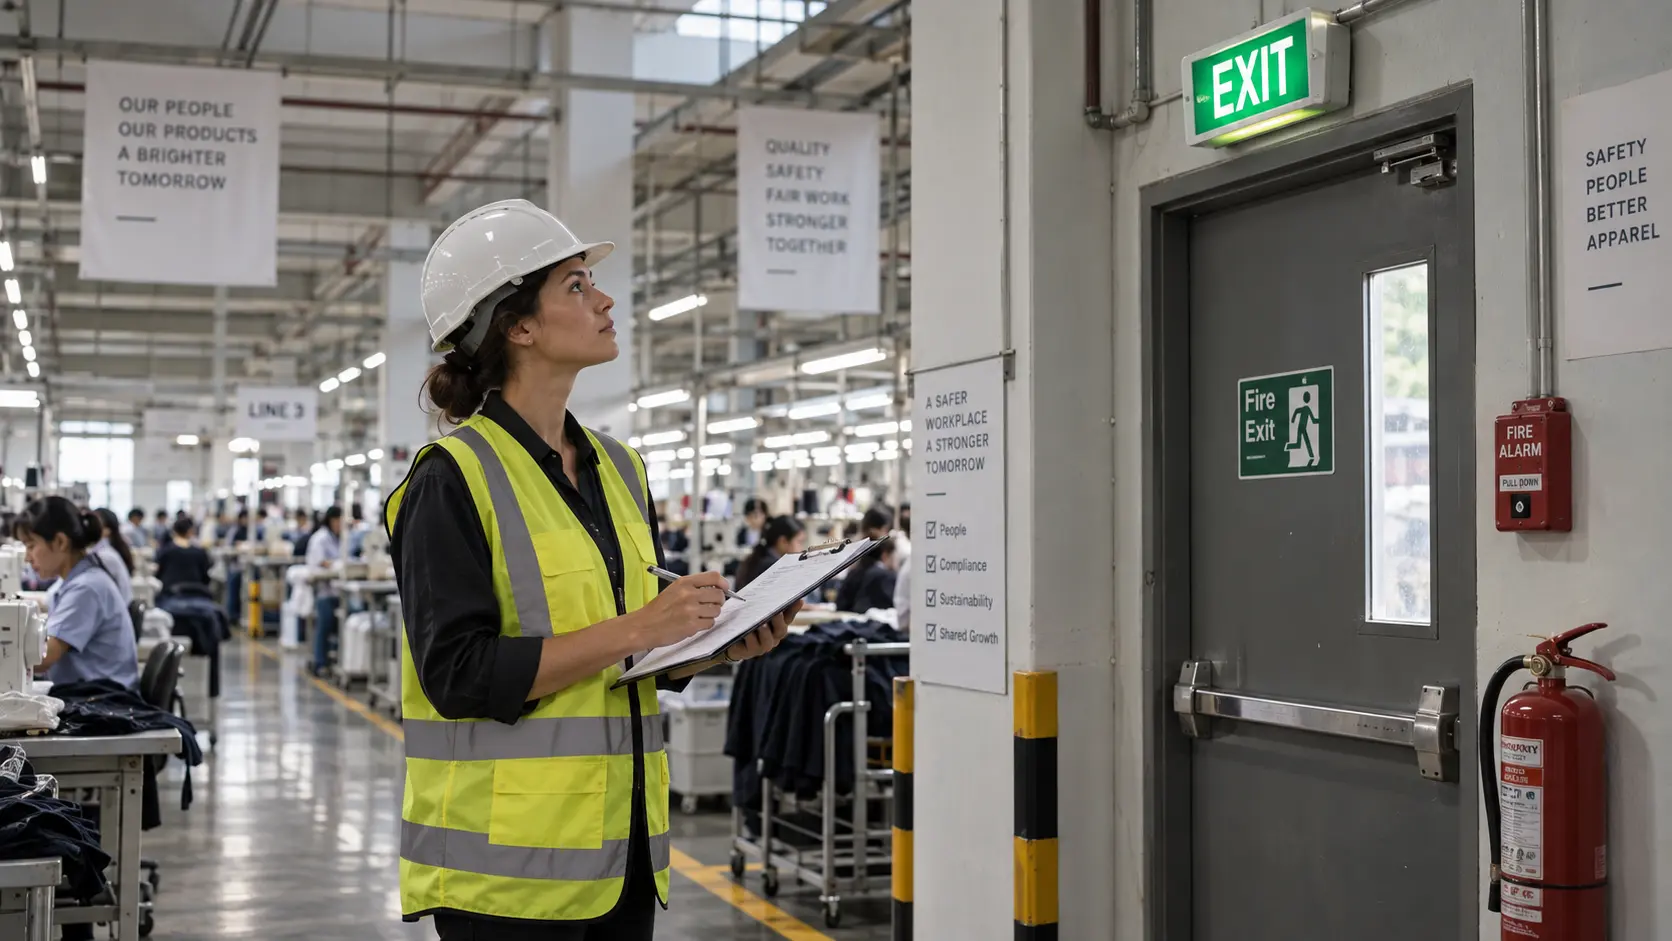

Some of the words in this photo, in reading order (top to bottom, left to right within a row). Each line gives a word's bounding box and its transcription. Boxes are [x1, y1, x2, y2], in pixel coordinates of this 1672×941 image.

[1212, 35, 1293, 119] EXIT
[118, 96, 158, 113] OUR
[165, 99, 234, 118] PEOPLE
[118, 121, 157, 138] OUR
[164, 123, 257, 143] PRODUCTS
[117, 145, 130, 161] A
[137, 147, 226, 166] BRIGHTER
[766, 138, 831, 156] QUALITY
[1586, 138, 1647, 167] SAFETY
[117, 170, 226, 190] TOMORROW
[766, 163, 825, 181] SAFETY
[1587, 167, 1647, 195] PEOPLE
[766, 187, 801, 203] FAIR
[805, 190, 850, 206] WORK
[1587, 196, 1647, 222] BETTER
[766, 212, 848, 230] STRONGER
[766, 236, 847, 255] TOGETHER
[1587, 223, 1660, 251] APPAREL
[926, 396, 932, 410] A
[935, 391, 968, 408] SAFER
[1245, 388, 1276, 412] Fire
[248, 402, 289, 418] LINE
[294, 402, 304, 419] 3
[925, 410, 988, 431] WORKPLACE
[1245, 418, 1276, 443] Exit
[1507, 424, 1533, 440] FIRE
[926, 440, 932, 453] A
[935, 433, 989, 452] STRONGER
[1499, 442, 1542, 458] ALARM
[926, 457, 985, 474] TOMORROW
[1502, 478, 1518, 487] PULL
[1519, 478, 1539, 487] DOWN
[940, 523, 967, 540] People
[940, 558, 987, 574] Compliance
[940, 592, 993, 611] Sustainability
[940, 627, 967, 642] Shared
[969, 629, 999, 644] Growth
